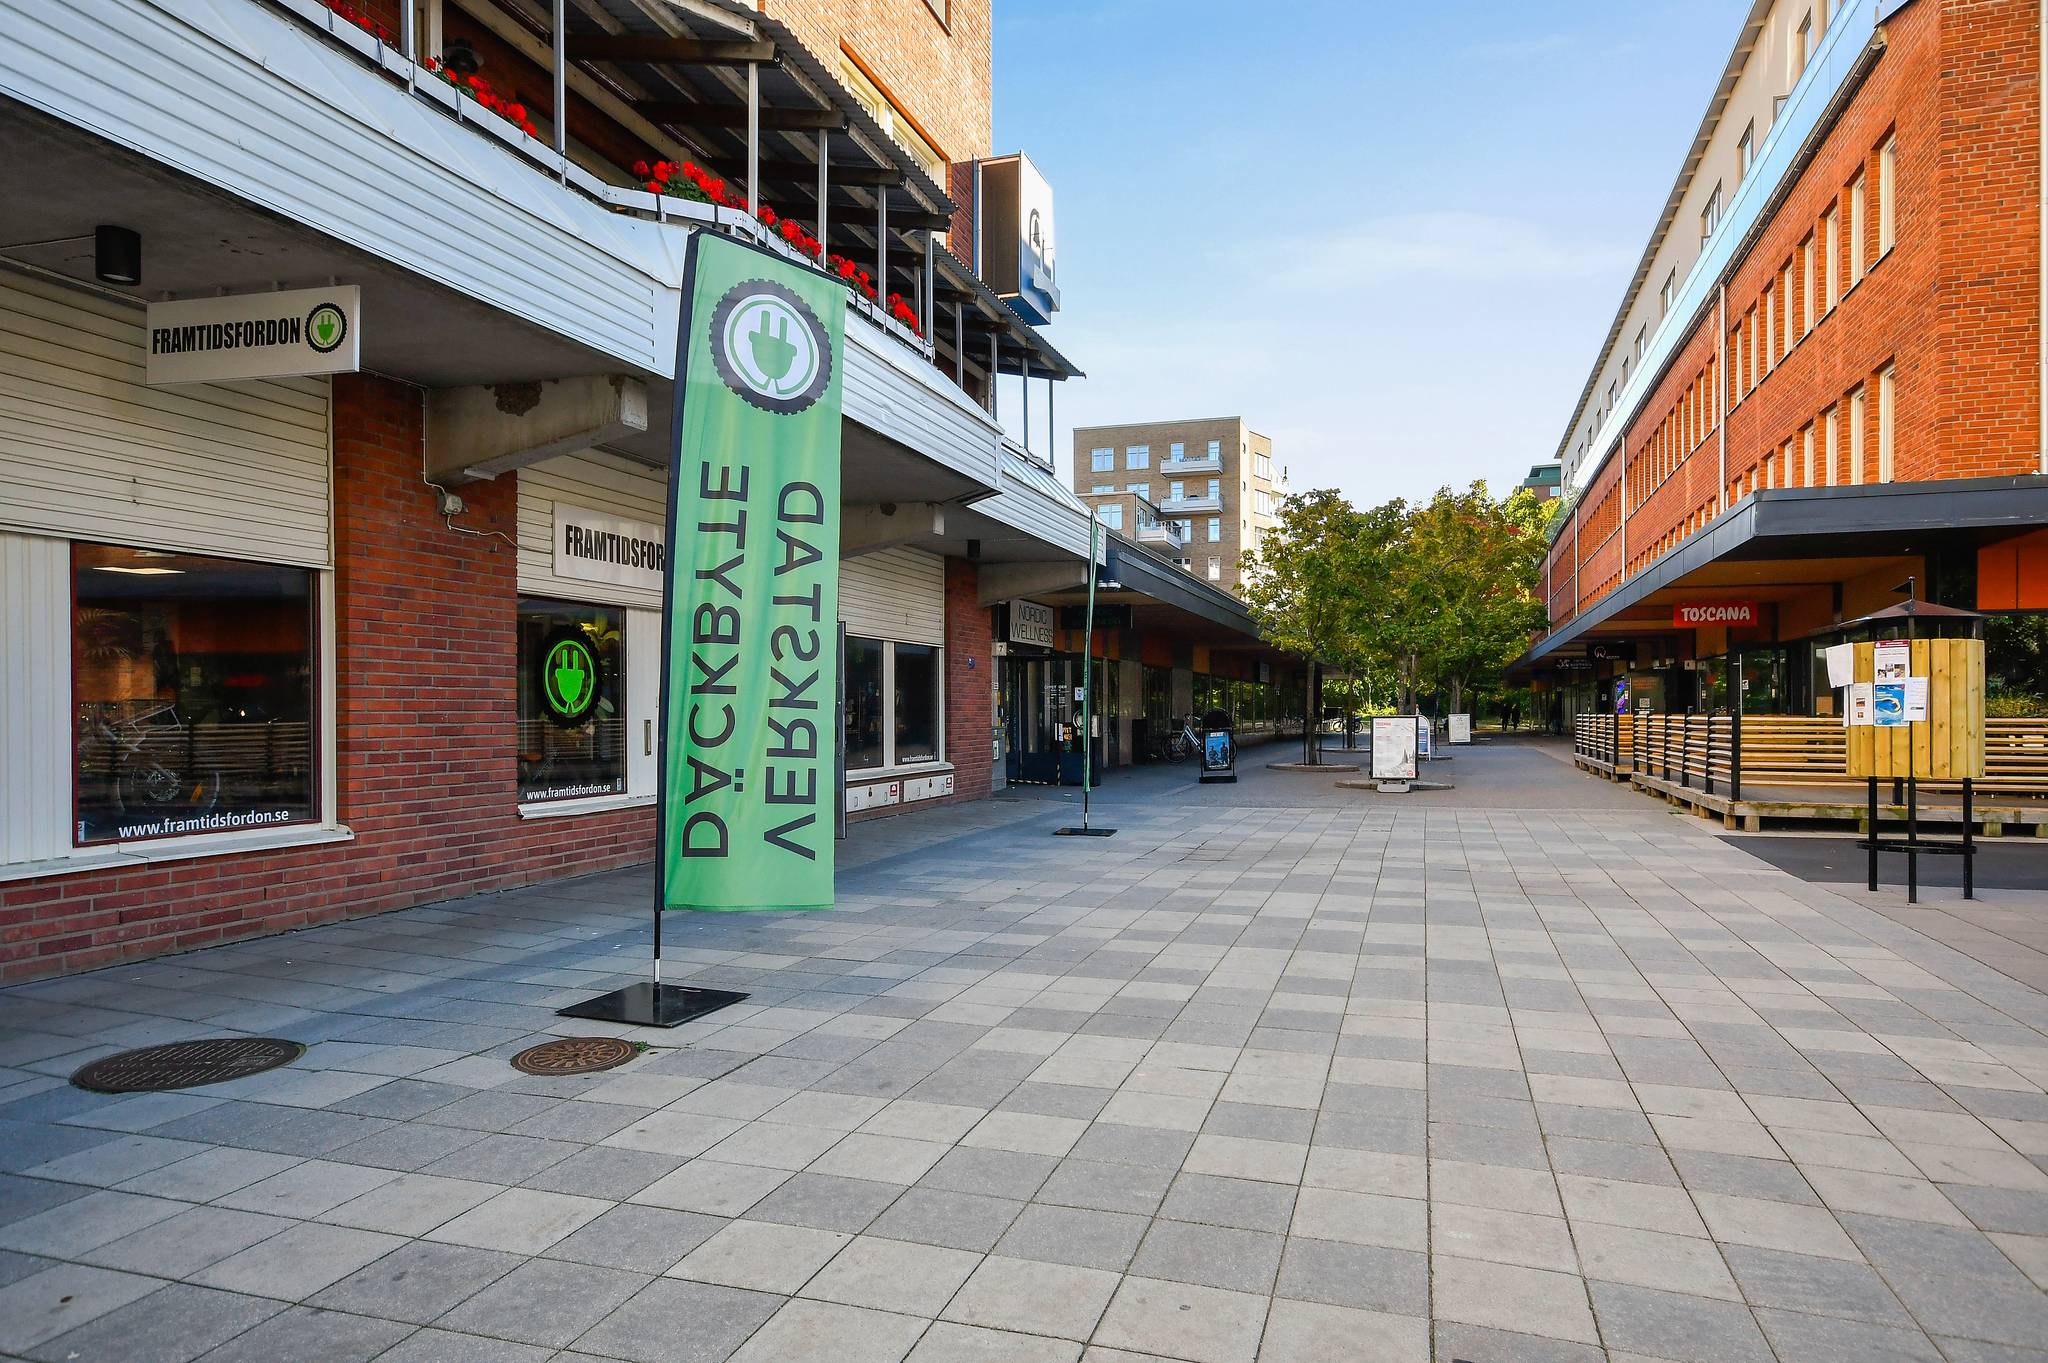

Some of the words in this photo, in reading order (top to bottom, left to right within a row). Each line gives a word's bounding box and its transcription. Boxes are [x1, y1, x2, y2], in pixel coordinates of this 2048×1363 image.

[152, 317, 300, 354] FRAMTIDSFORDON
[1018, 604, 1047, 625] NORDIC
[1681, 606, 1750, 622] TOSCANA
[1011, 622, 1053, 644] WELLNESS
[526, 784, 611, 800] www.framtidsfordon.se
[118, 810, 289, 838] www.framtidsfordon.se
